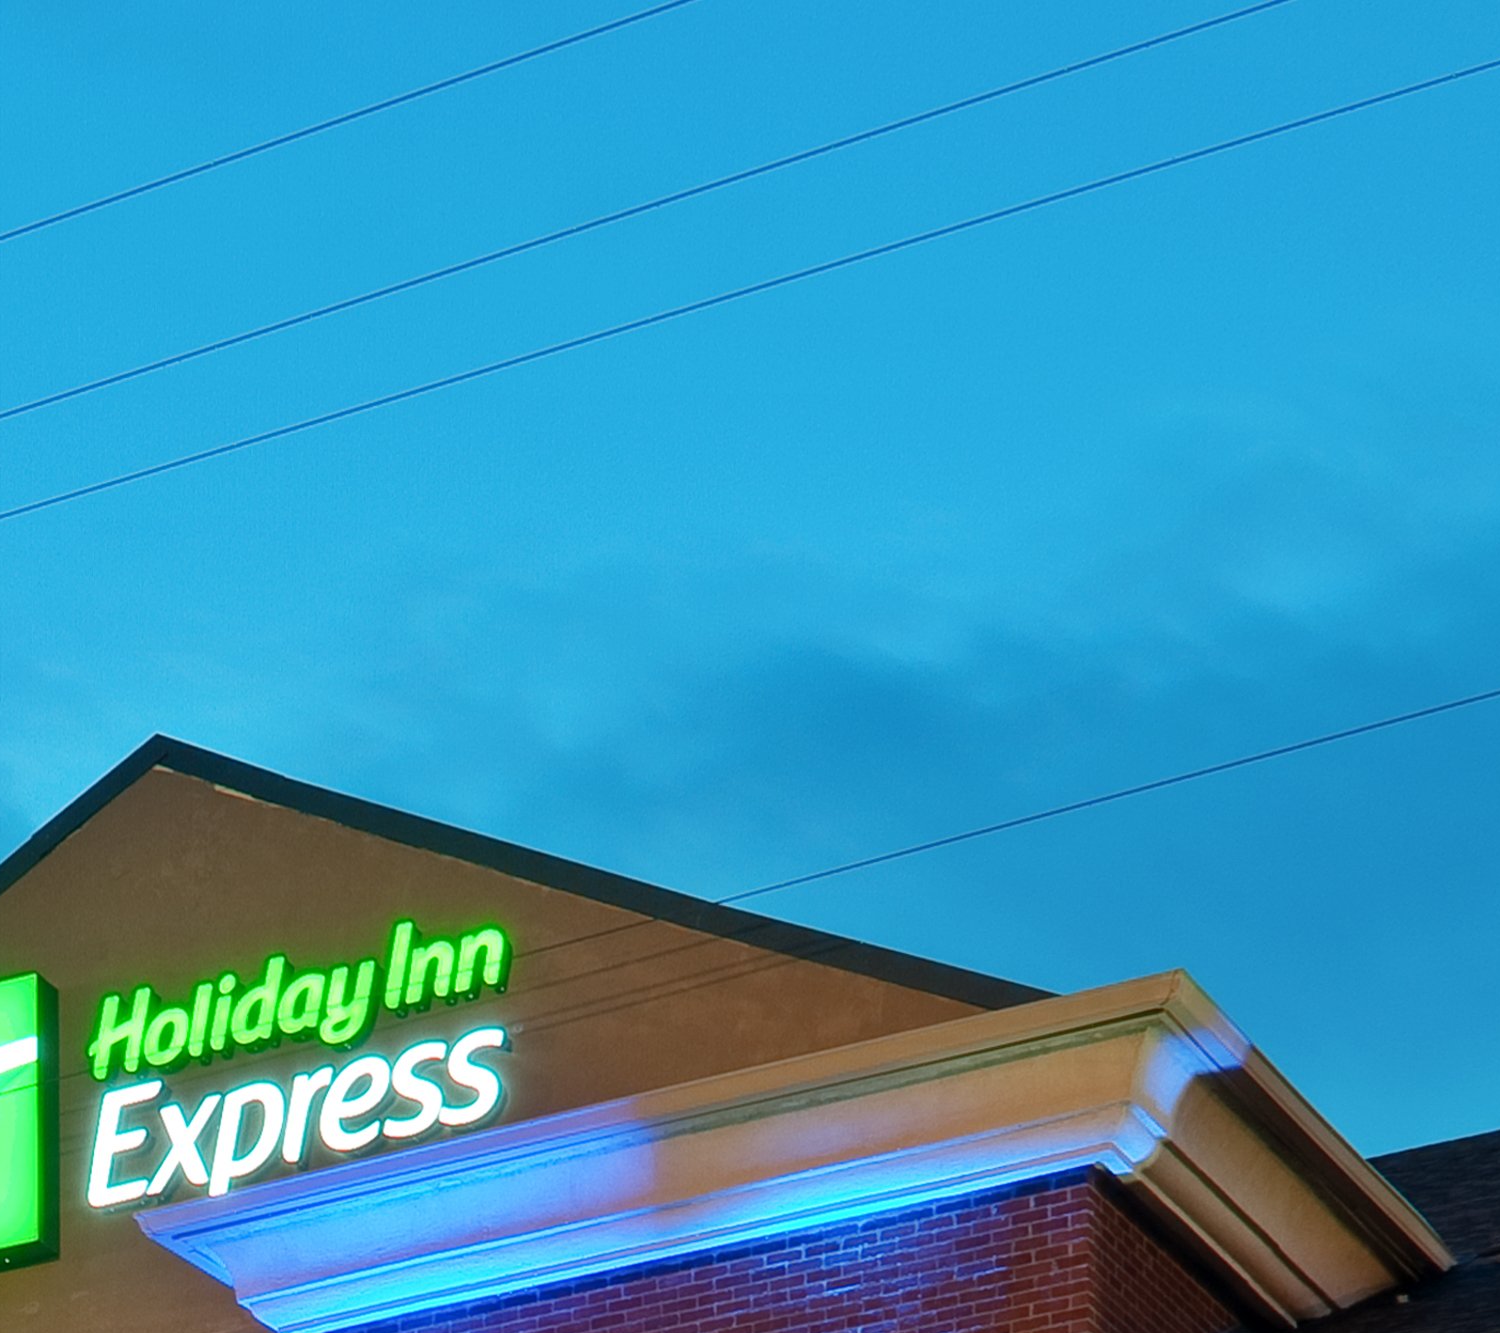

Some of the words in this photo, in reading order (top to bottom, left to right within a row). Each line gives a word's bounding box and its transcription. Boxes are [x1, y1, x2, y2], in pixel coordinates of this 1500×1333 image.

[89, 955, 375, 1080] Holiday
[384, 920, 506, 1010] Inn
[87, 1027, 507, 1209] Express
